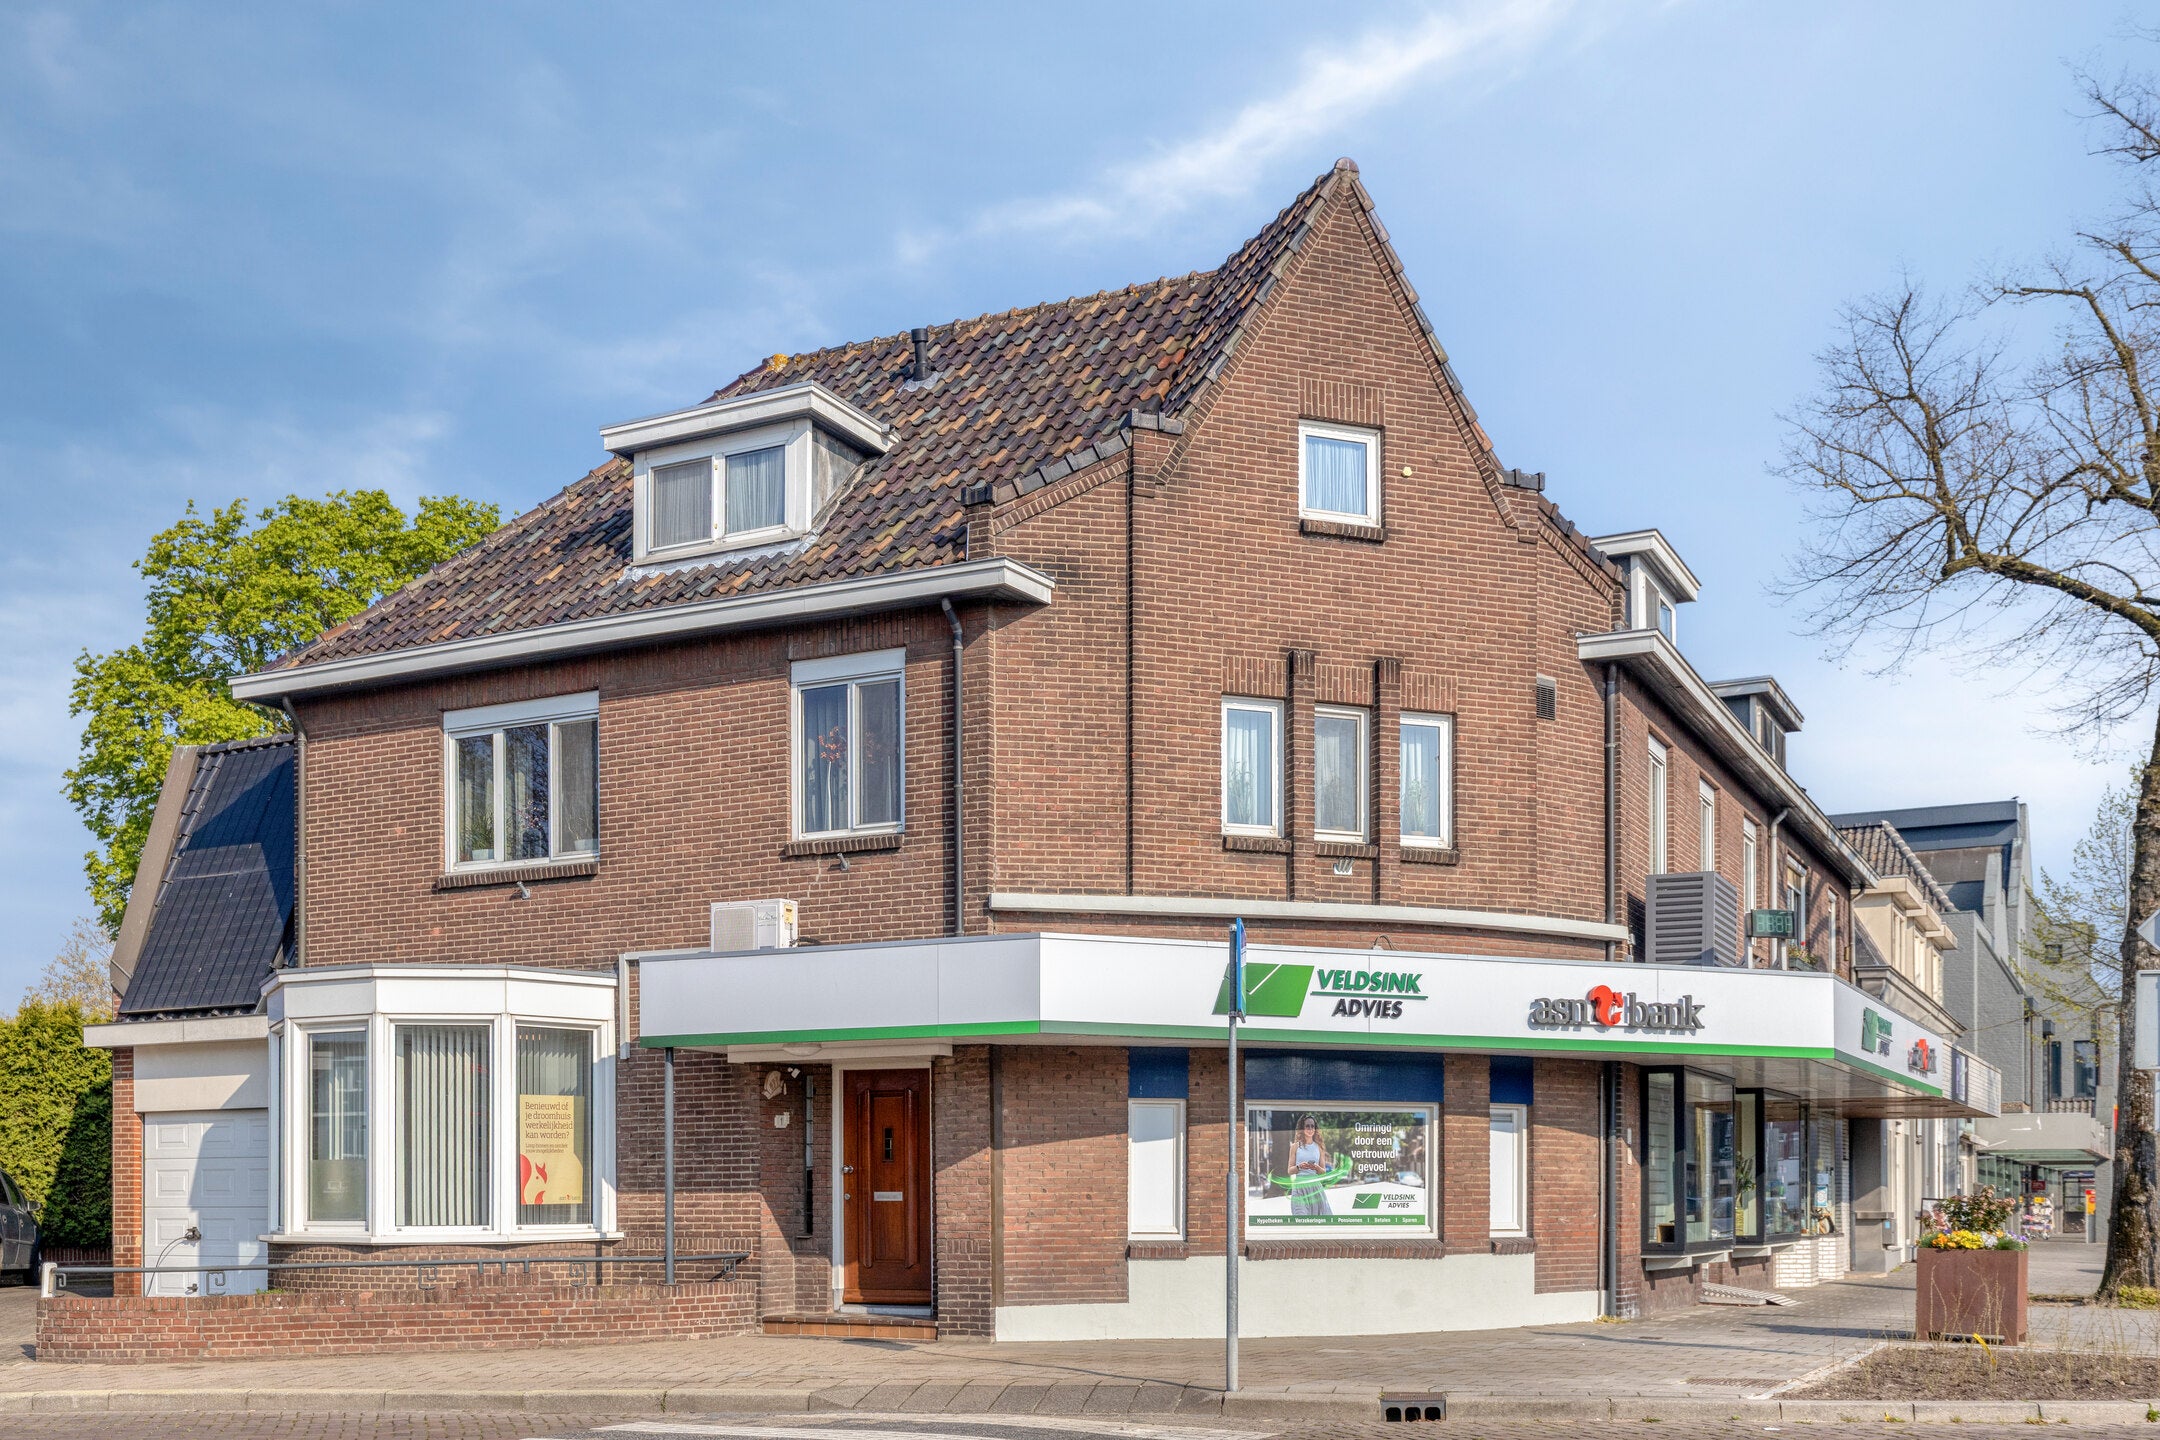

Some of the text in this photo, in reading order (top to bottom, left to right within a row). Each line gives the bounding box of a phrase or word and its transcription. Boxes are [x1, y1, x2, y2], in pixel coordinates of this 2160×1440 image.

[1317, 968, 1423, 993] VELDSINK
[1331, 998, 1404, 1019] ADVIES
[1532, 992, 1706, 1030] asn bank
[525, 1101, 569, 1111] Benieuwd of
[525, 1111, 571, 1121] je droomhuis
[525, 1120, 573, 1131] werkelijkheid
[1355, 1122, 1392, 1134] Omringd
[525, 1131, 570, 1139] kan worden?
[1354, 1136, 1393, 1146] door een
[1351, 1149, 1396, 1159] vertrouwd
[1358, 1162, 1389, 1173] gevoel.
